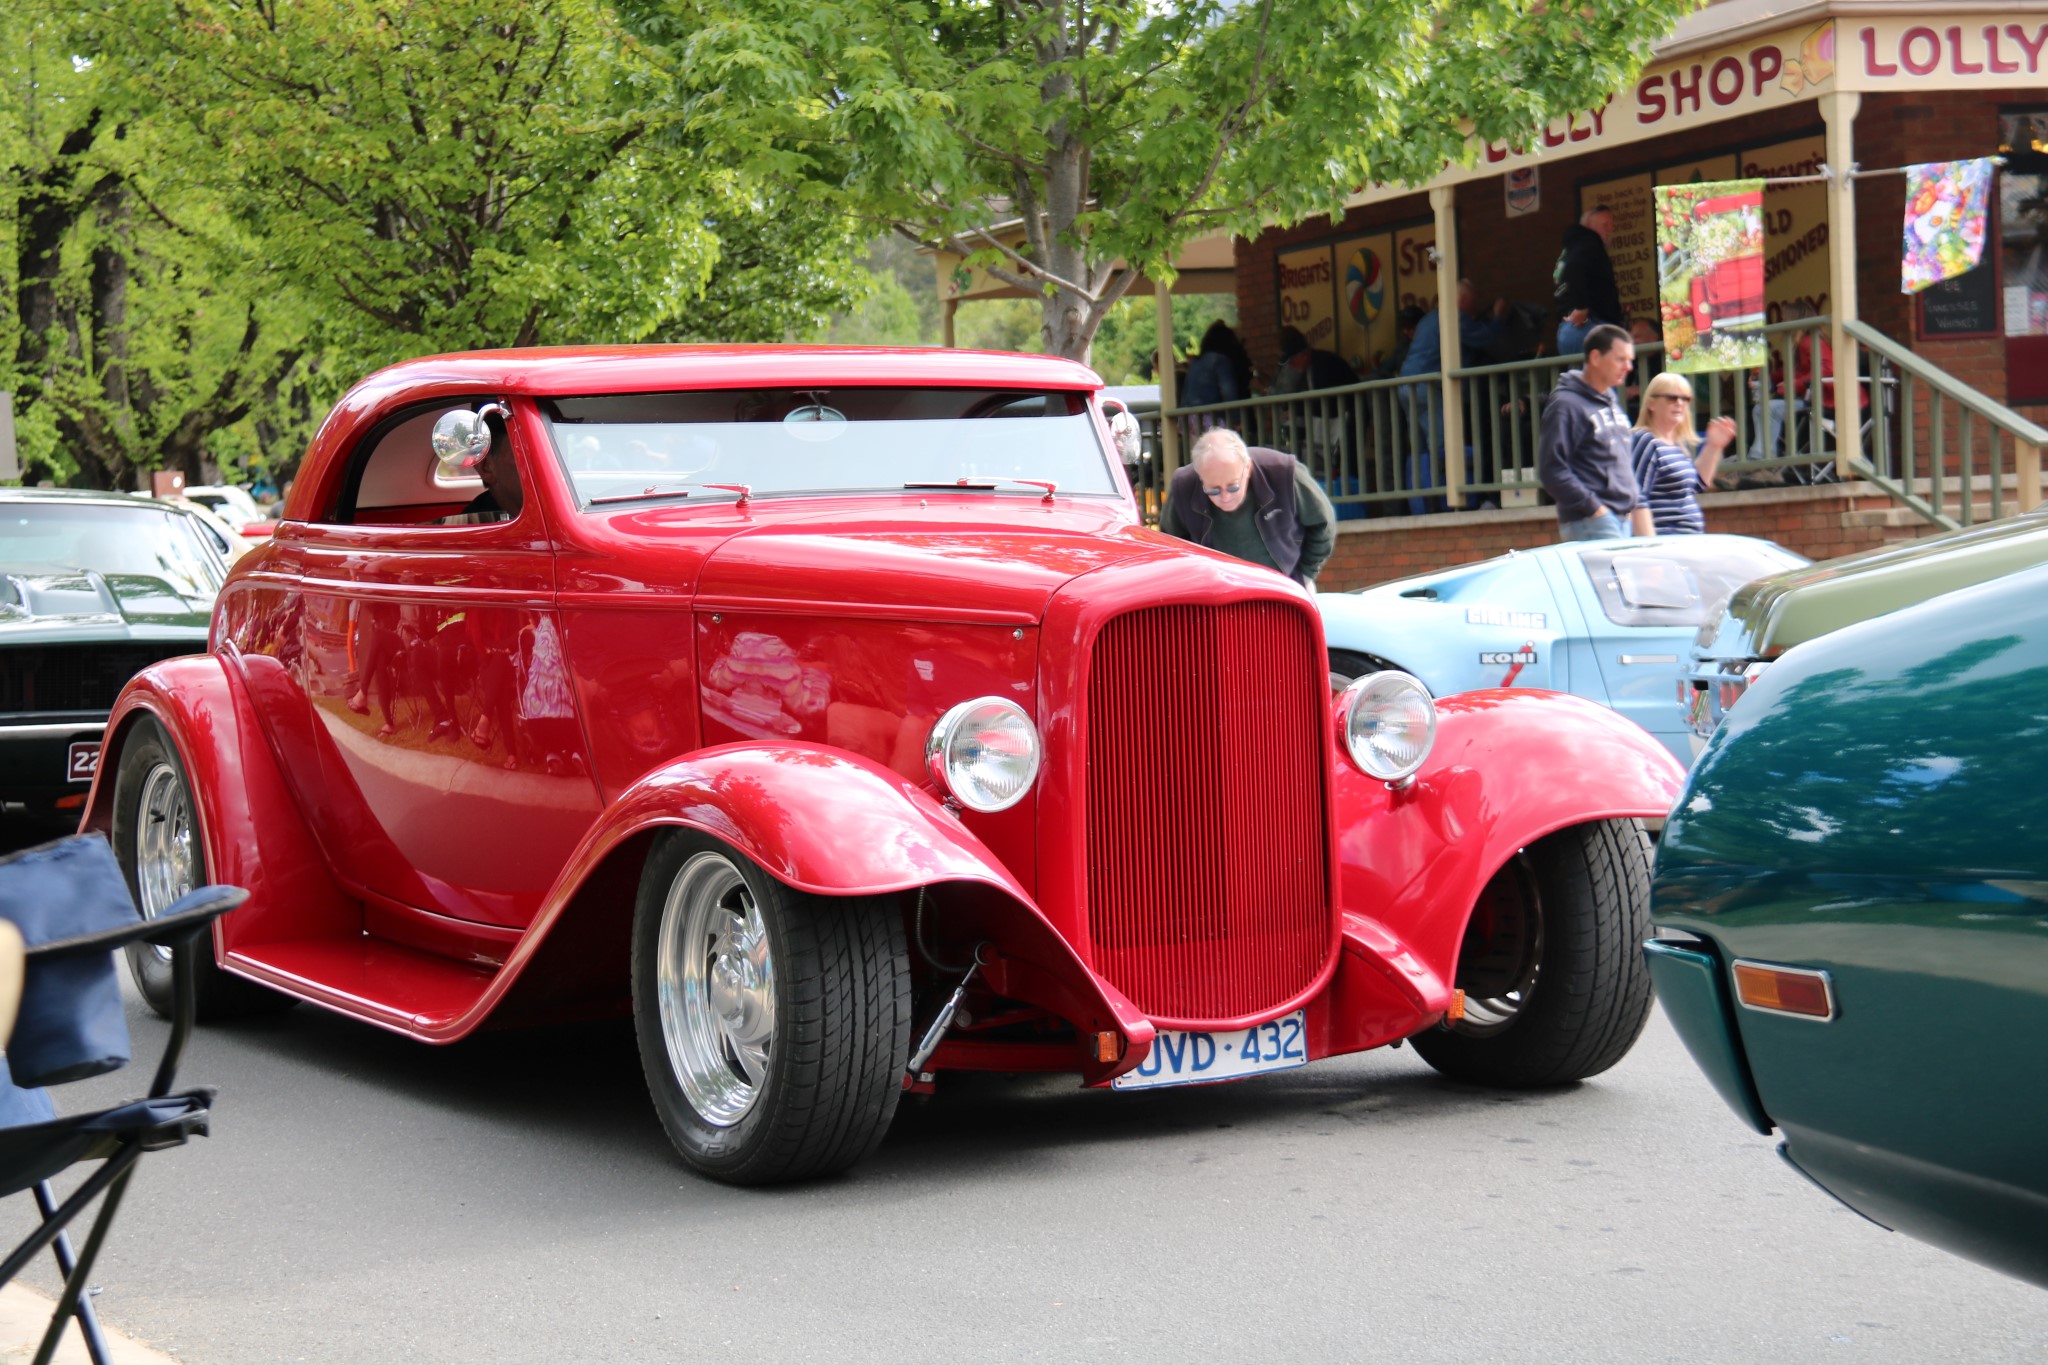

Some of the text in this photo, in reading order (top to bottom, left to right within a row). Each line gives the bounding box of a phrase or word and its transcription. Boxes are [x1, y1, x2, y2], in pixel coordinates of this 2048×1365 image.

[1860, 24, 2048, 77] LOLLY
[1485, 45, 1782, 163] LLLY SHOP
[1766, 208, 1792, 236] LD
[1764, 221, 1828, 283] SHIONED
[1278, 257, 1330, 290] BRIGHT'S
[1282, 295, 1310, 323] OLD
[1481, 652, 1535, 664] KONI
[74, 751, 99, 771] 22
